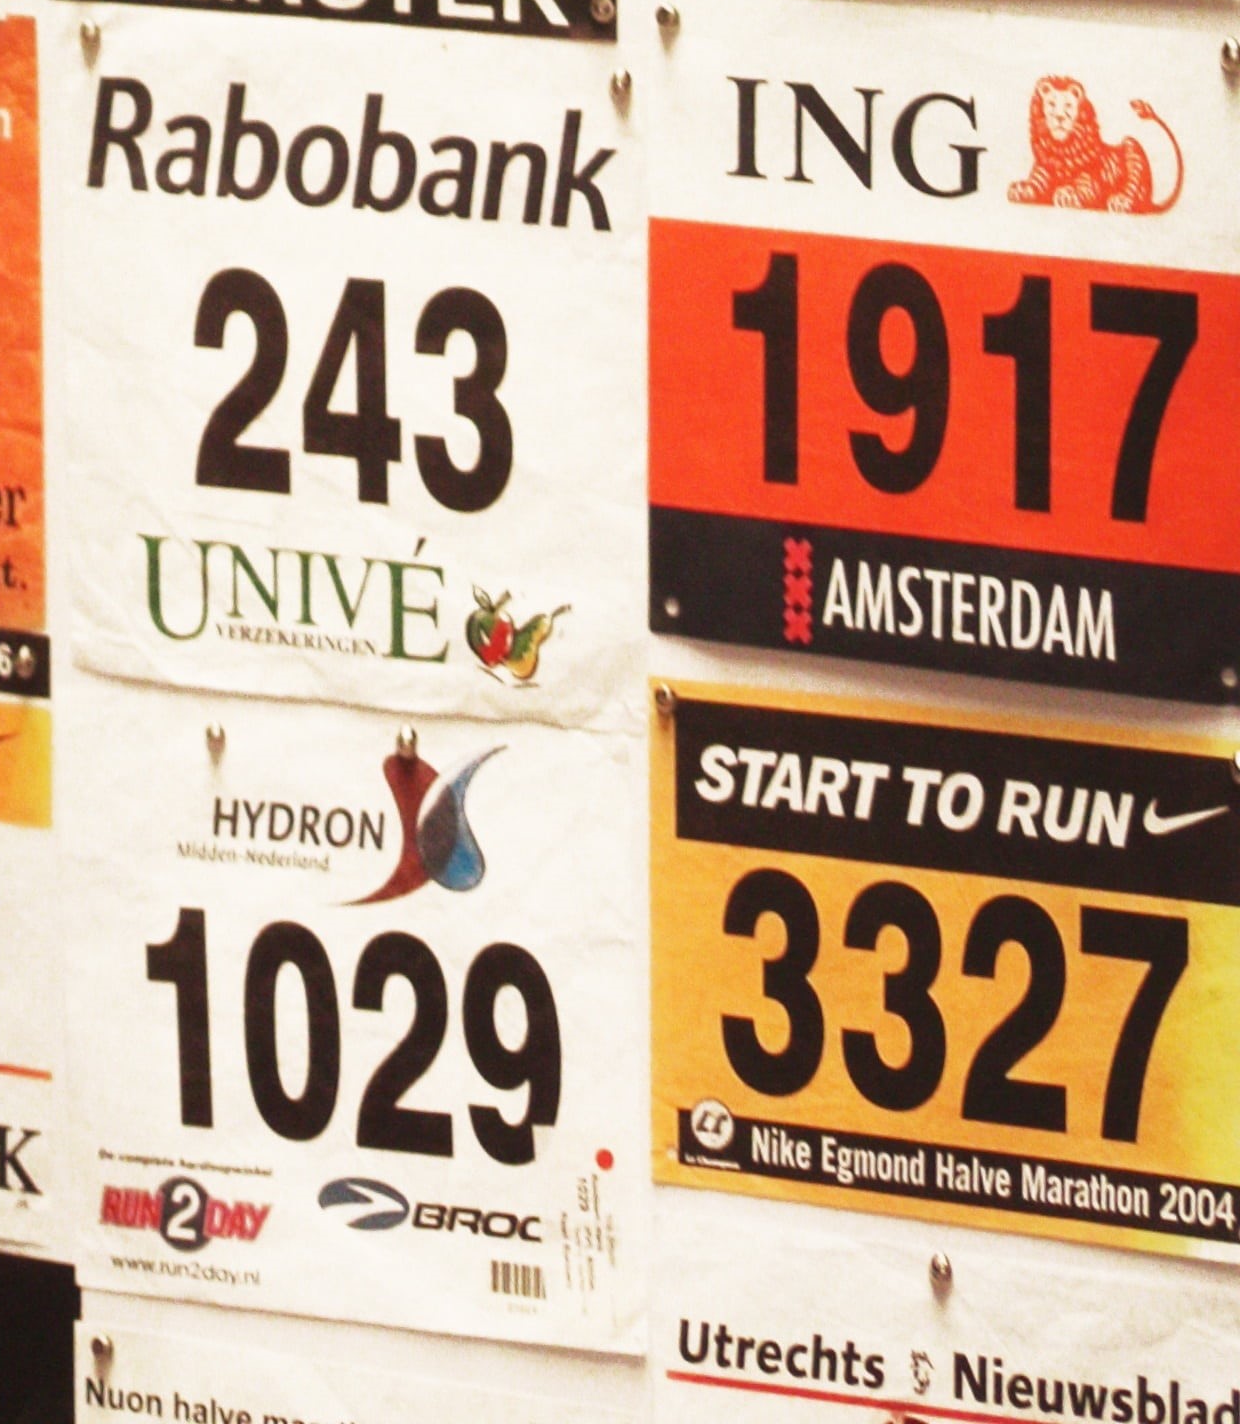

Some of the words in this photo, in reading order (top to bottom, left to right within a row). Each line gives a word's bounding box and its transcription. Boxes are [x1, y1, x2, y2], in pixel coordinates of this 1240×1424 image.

[86, 76, 618, 233] Rabobank
[726, 75, 989, 200] ING
[194, 267, 514, 514] 243
[732, 249, 1199, 525] 1917
[216, 622, 376, 657] VERZEKERINGEN
[822, 558, 1117, 662] AMSTERDAM
[211, 796, 386, 851] HYDRON
[693, 744, 889, 827] START
[901, 769, 984, 834] TO
[996, 780, 1134, 849] RUN
[176, 840, 332, 873] Midden-Nederland
[145, 906, 563, 1167] 1029
[721, 866, 1189, 1145] 3327
[751, 1125, 813, 1170] Nike
[821, 1135, 925, 1188] Egmond
[935, 1149, 1012, 1200] Halve
[1020, 1162, 1150, 1219] Marathon
[1159, 1183, 1235, 1229] 2004
